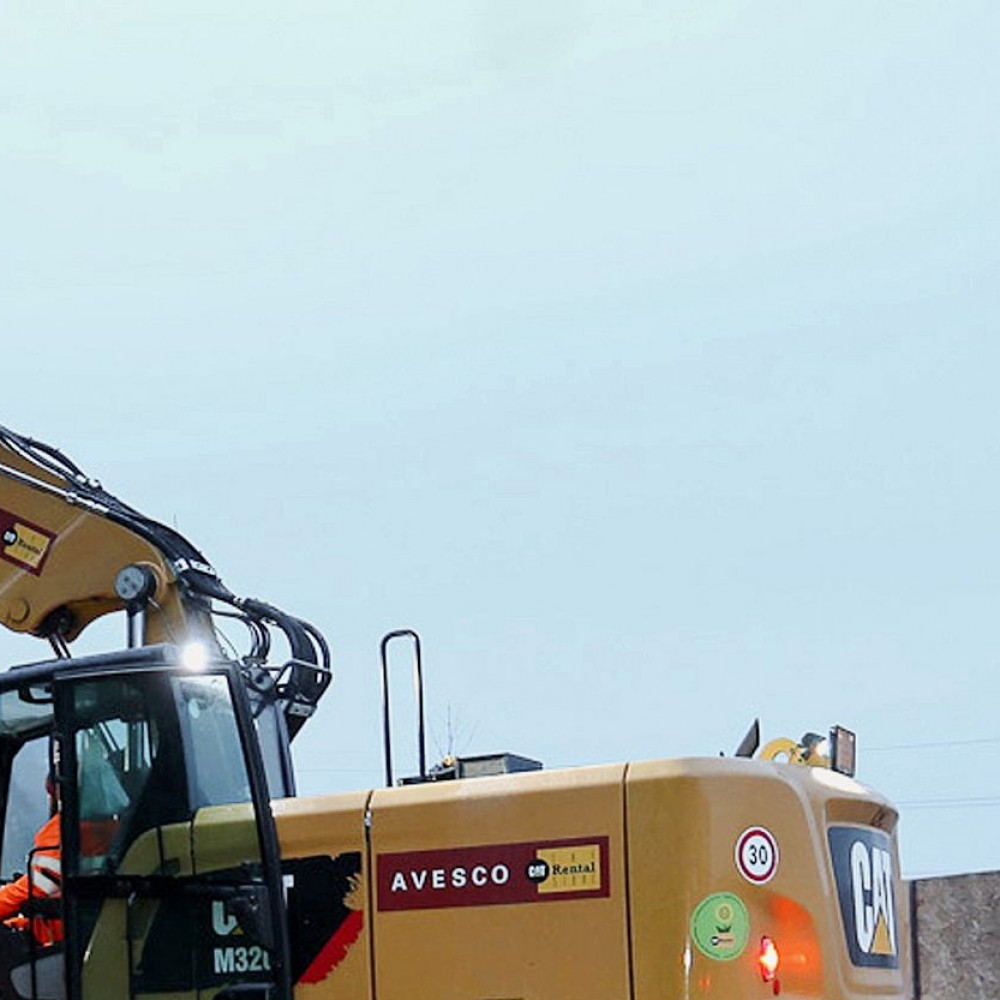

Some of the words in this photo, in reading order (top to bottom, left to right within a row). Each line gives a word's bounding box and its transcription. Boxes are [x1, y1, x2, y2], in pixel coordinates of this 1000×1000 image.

[749, 845, 768, 866] 30
[391, 864, 510, 892] AVESCO
[552, 861, 595, 875] Rental
